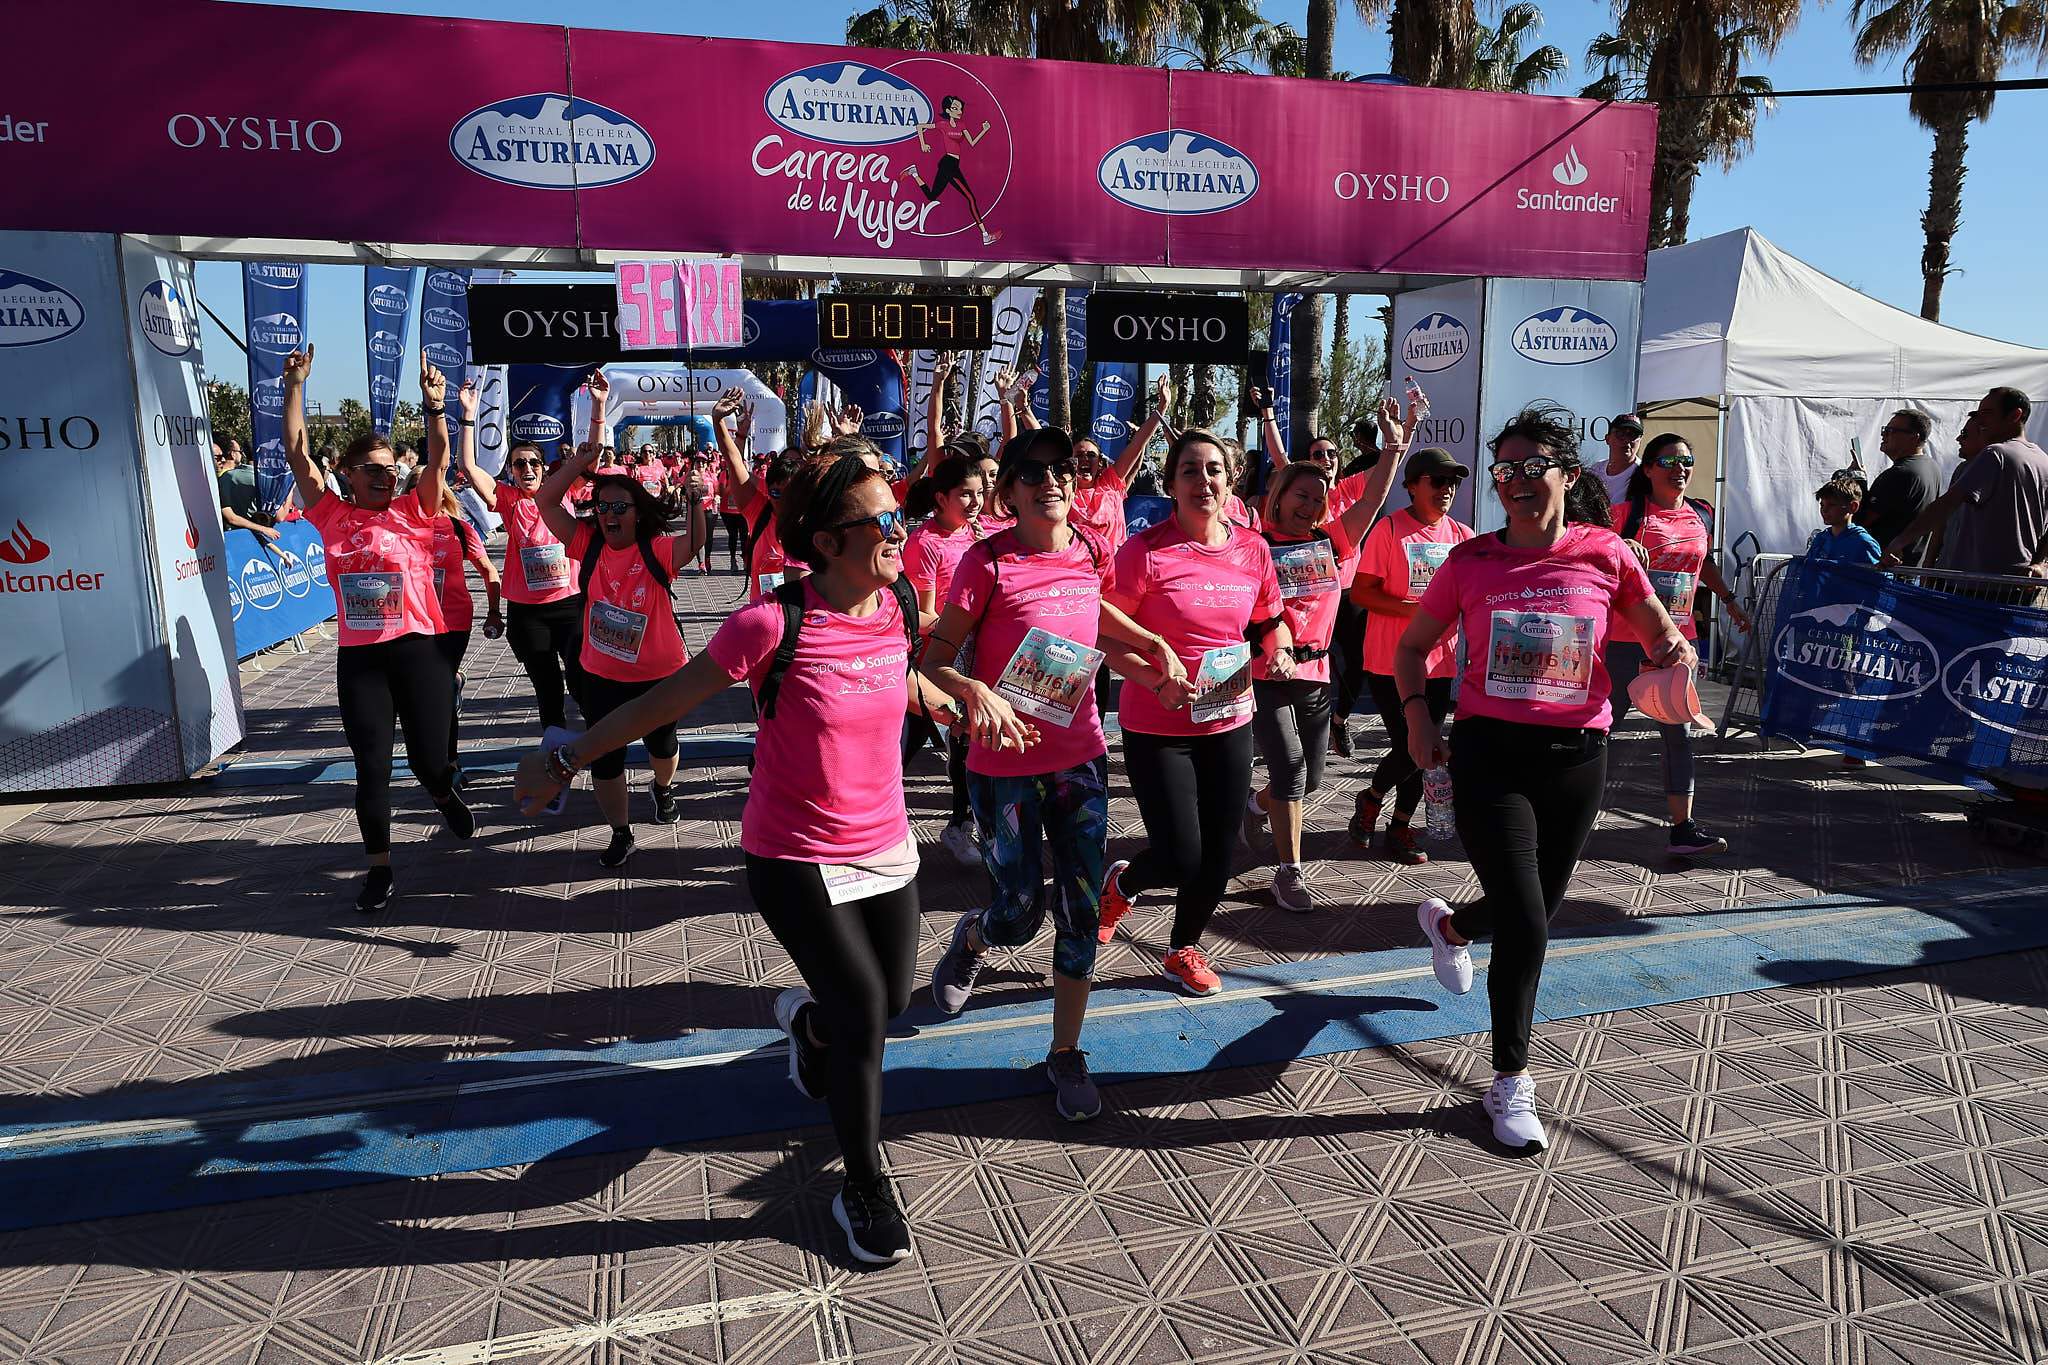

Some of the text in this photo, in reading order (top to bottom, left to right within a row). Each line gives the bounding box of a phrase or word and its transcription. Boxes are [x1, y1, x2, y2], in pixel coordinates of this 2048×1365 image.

[778, 88, 919, 127] ASTURIANA
[804, 88, 916, 102] CENTRAL LECHERA
[167, 114, 343, 153] OYSHO
[497, 125, 562, 136] CENTRAL
[467, 125, 641, 166] ASTURIANA
[752, 134, 890, 183] Carrera
[1110, 158, 1247, 195] ASTURIANA
[1135, 157, 1242, 170] CENTRAL LECHERA
[1333, 172, 1450, 203] OYSHO
[1516, 188, 1619, 214] Santander
[787, 180, 941, 249] de la Mujer
[3, 295, 63, 304] LECHERA
[144, 302, 192, 340] ASTURIANA
[503, 310, 622, 339] OYSH
[831, 304, 979, 339] 01:07:47
[1114, 315, 1226, 343] OYSHO
[1405, 338, 1464, 360] ASTURIANA
[1518, 328, 1609, 351] ASTURIANA
[818, 351, 873, 363] ASTURIANA
[637, 376, 722, 393] OYSHO
[154, 414, 206, 447] OYSHO
[514, 425, 562, 436] ASTURIANA
[175, 555, 216, 581] Santander
[1174, 581, 1253, 592] Sports Santander
[1485, 586, 1593, 605] Sports Santander
[1780, 626, 1922, 687] ASTURIANA
[1865, 638, 1922, 657] LECHERA
[810, 660, 851, 674] Sports
[1496, 684, 1527, 694] OYSHO
